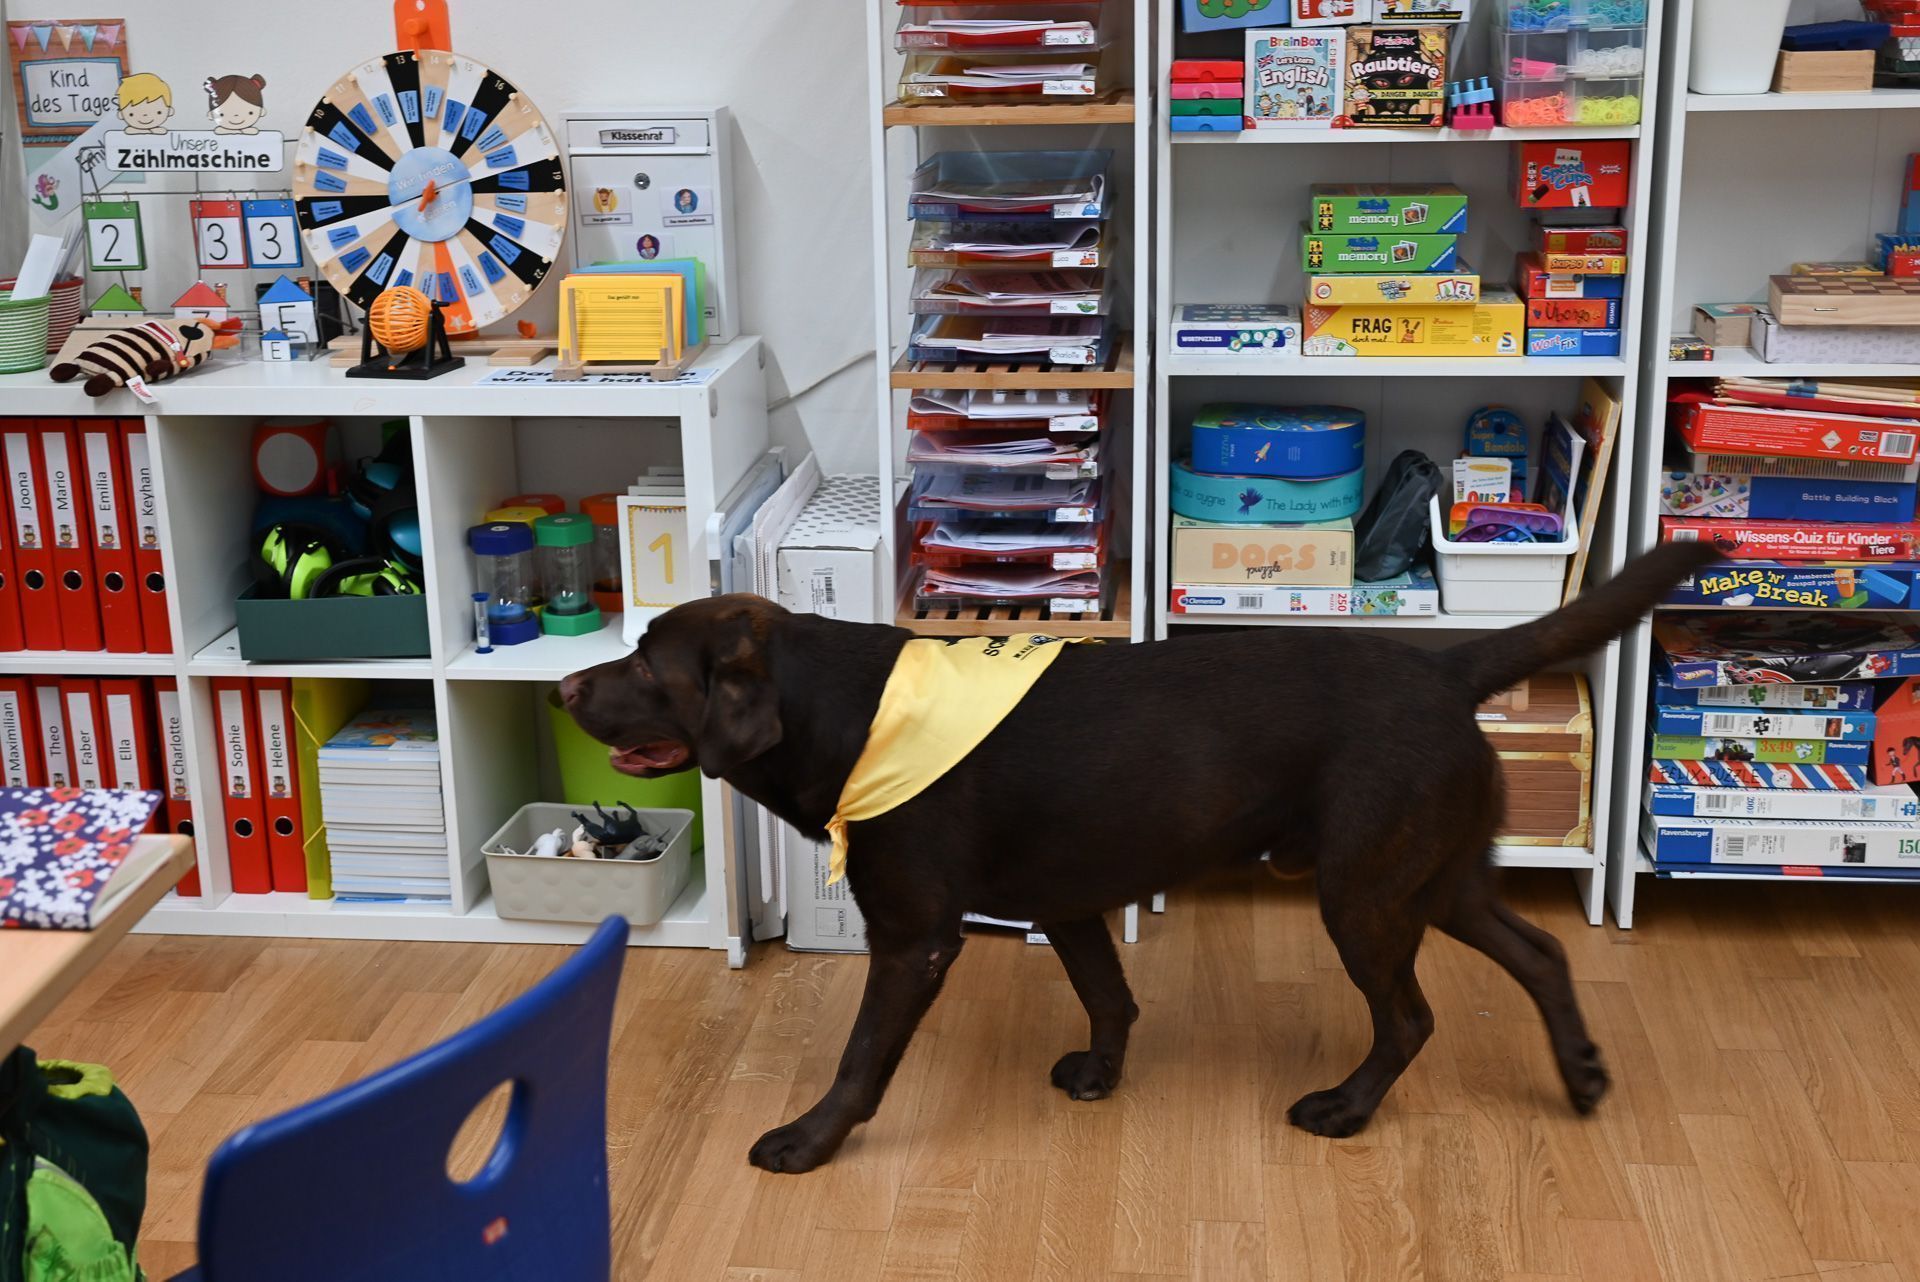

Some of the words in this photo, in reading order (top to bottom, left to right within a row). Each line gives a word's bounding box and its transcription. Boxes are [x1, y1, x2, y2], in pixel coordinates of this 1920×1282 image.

[1270, 36, 1323, 47] BrainBox
[396, 55, 406, 65] 13
[1351, 56, 1440, 80] Raubtiere
[49, 69, 90, 88] Kind
[493, 79, 505, 91] 16
[1259, 65, 1329, 90] English
[31, 94, 62, 114] des
[67, 93, 121, 117] Tages
[170, 132, 219, 151] Unsere
[611, 130, 664, 141] Klassenrat
[117, 148, 271, 169] Zählmaschine
[1540, 161, 1585, 184] Speed
[1553, 172, 1594, 190] Cups
[1349, 214, 1399, 227] memory
[101, 224, 122, 262] 2
[208, 223, 228, 260] 3
[262, 222, 282, 260] 3
[1337, 252, 1388, 264] memory
[1608, 301, 1616, 325] KOSMOS
[1352, 318, 1392, 334] FRAG
[270, 341, 281, 360] E
[18, 471, 32, 511] Joona
[54, 470, 68, 510] Mario
[96, 471, 111, 511] Emilia
[140, 467, 155, 516] Keyhan
[1802, 492, 1831, 502] Battle
[1835, 493, 1870, 505] Building
[1874, 495, 1899, 503] Block
[1266, 498, 1286, 511] The
[1289, 499, 1317, 513] Lady
[1320, 496, 1342, 510] with
[1735, 530, 1823, 546] Wissens-Quiz
[1827, 532, 1846, 545] für
[1848, 533, 1892, 545] Kinder
[648, 532, 674, 585] 1
[1212, 542, 1317, 570] DOGS
[1869, 545, 1896, 556] Tiere
[1246, 560, 1283, 580] puzzle
[1700, 569, 1765, 596] Make
[1189, 597, 1224, 606] Clementoni
[1337, 592, 1347, 612] 250
[1754, 583, 1829, 608] Break
[1662, 712, 1702, 720] Ravensburger
[3, 702, 21, 771] Maximilian
[50, 725, 62, 757] Theo
[170, 716, 186, 776] Charlotte
[229, 724, 244, 767] Sophie
[270, 723, 284, 768] Helene
[1760, 739, 1795, 753] 3x49
[1828, 742, 1868, 750] Ravensburger
[81, 730, 93, 765] Faber
[120, 739, 132, 761] Ella
[1709, 764, 1760, 784] PUZZLE
[1660, 828, 1710, 838] Ravensburger
[838, 909, 846, 936] TimeTEX
